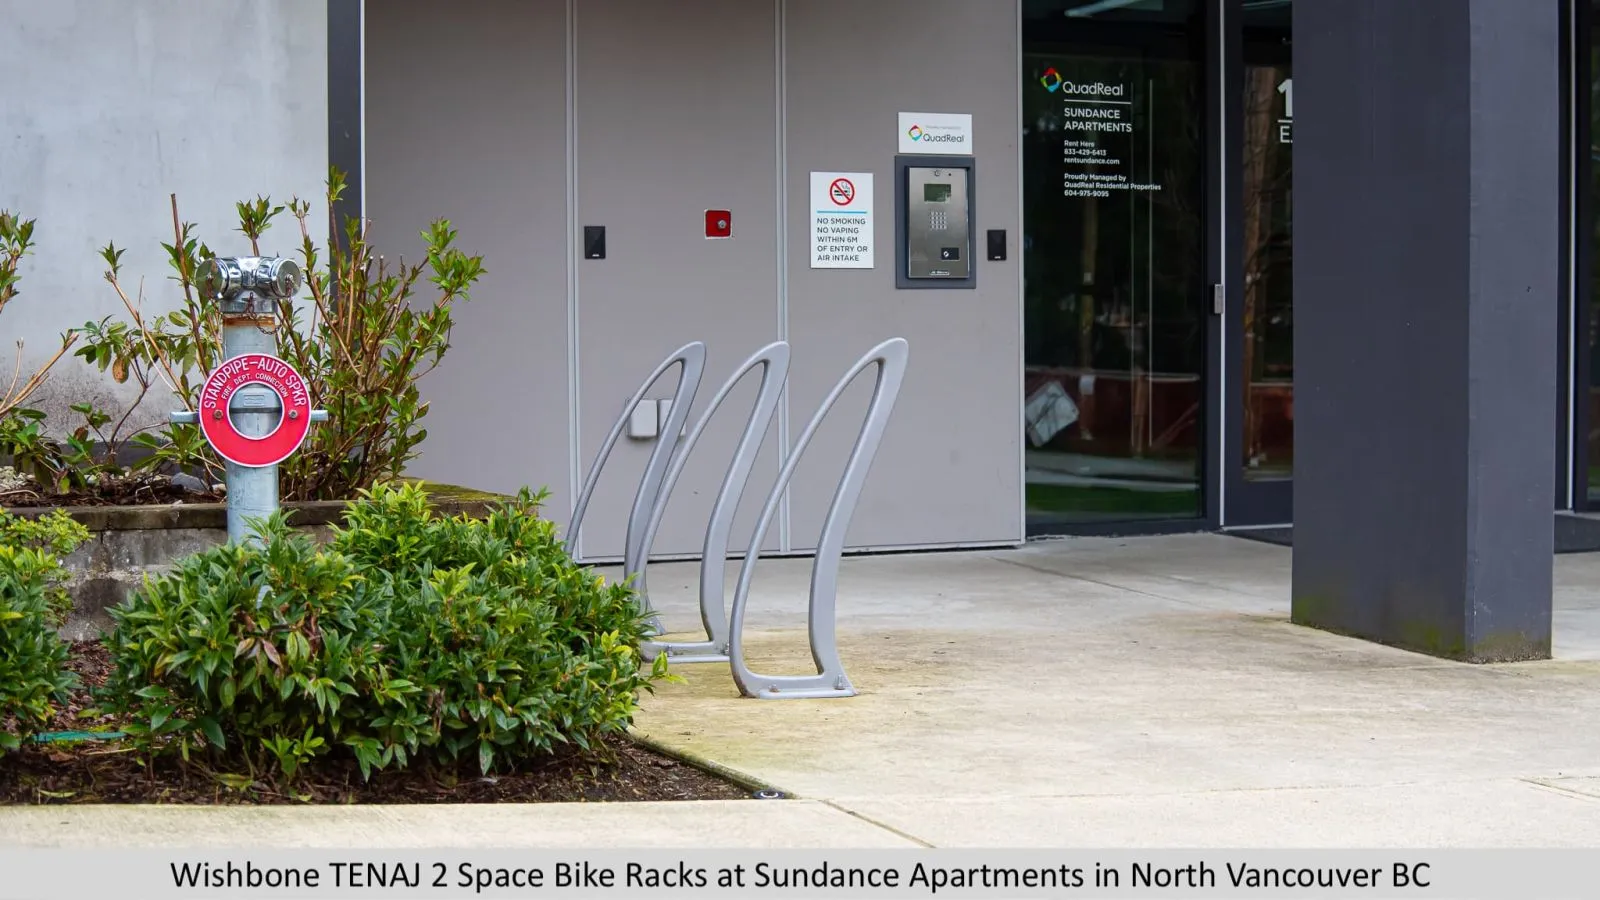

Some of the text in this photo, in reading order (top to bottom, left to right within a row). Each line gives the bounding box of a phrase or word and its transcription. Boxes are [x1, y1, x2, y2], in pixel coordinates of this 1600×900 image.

[1062, 81, 1124, 96] QuadReal
[1064, 108, 1120, 119] SUNDANCE
[1064, 121, 1132, 133] APARTMENTS
[923, 133, 965, 143] QuadReal
[1280, 125, 1293, 143] E
[1064, 157, 1120, 165] rentsundance.com
[1064, 173, 1088, 181] Proudly
[1089, 174, 1117, 182] Managed
[1095, 182, 1129, 190] Residential
[1130, 183, 1162, 192] Properties
[816, 217, 829, 225] NO
[817, 245, 828, 253] OF
[817, 254, 831, 262] AIR
[221, 385, 233, 400] FIRE
[255, 372, 289, 398] CONNECTION
[285, 374, 307, 407] SPKR
